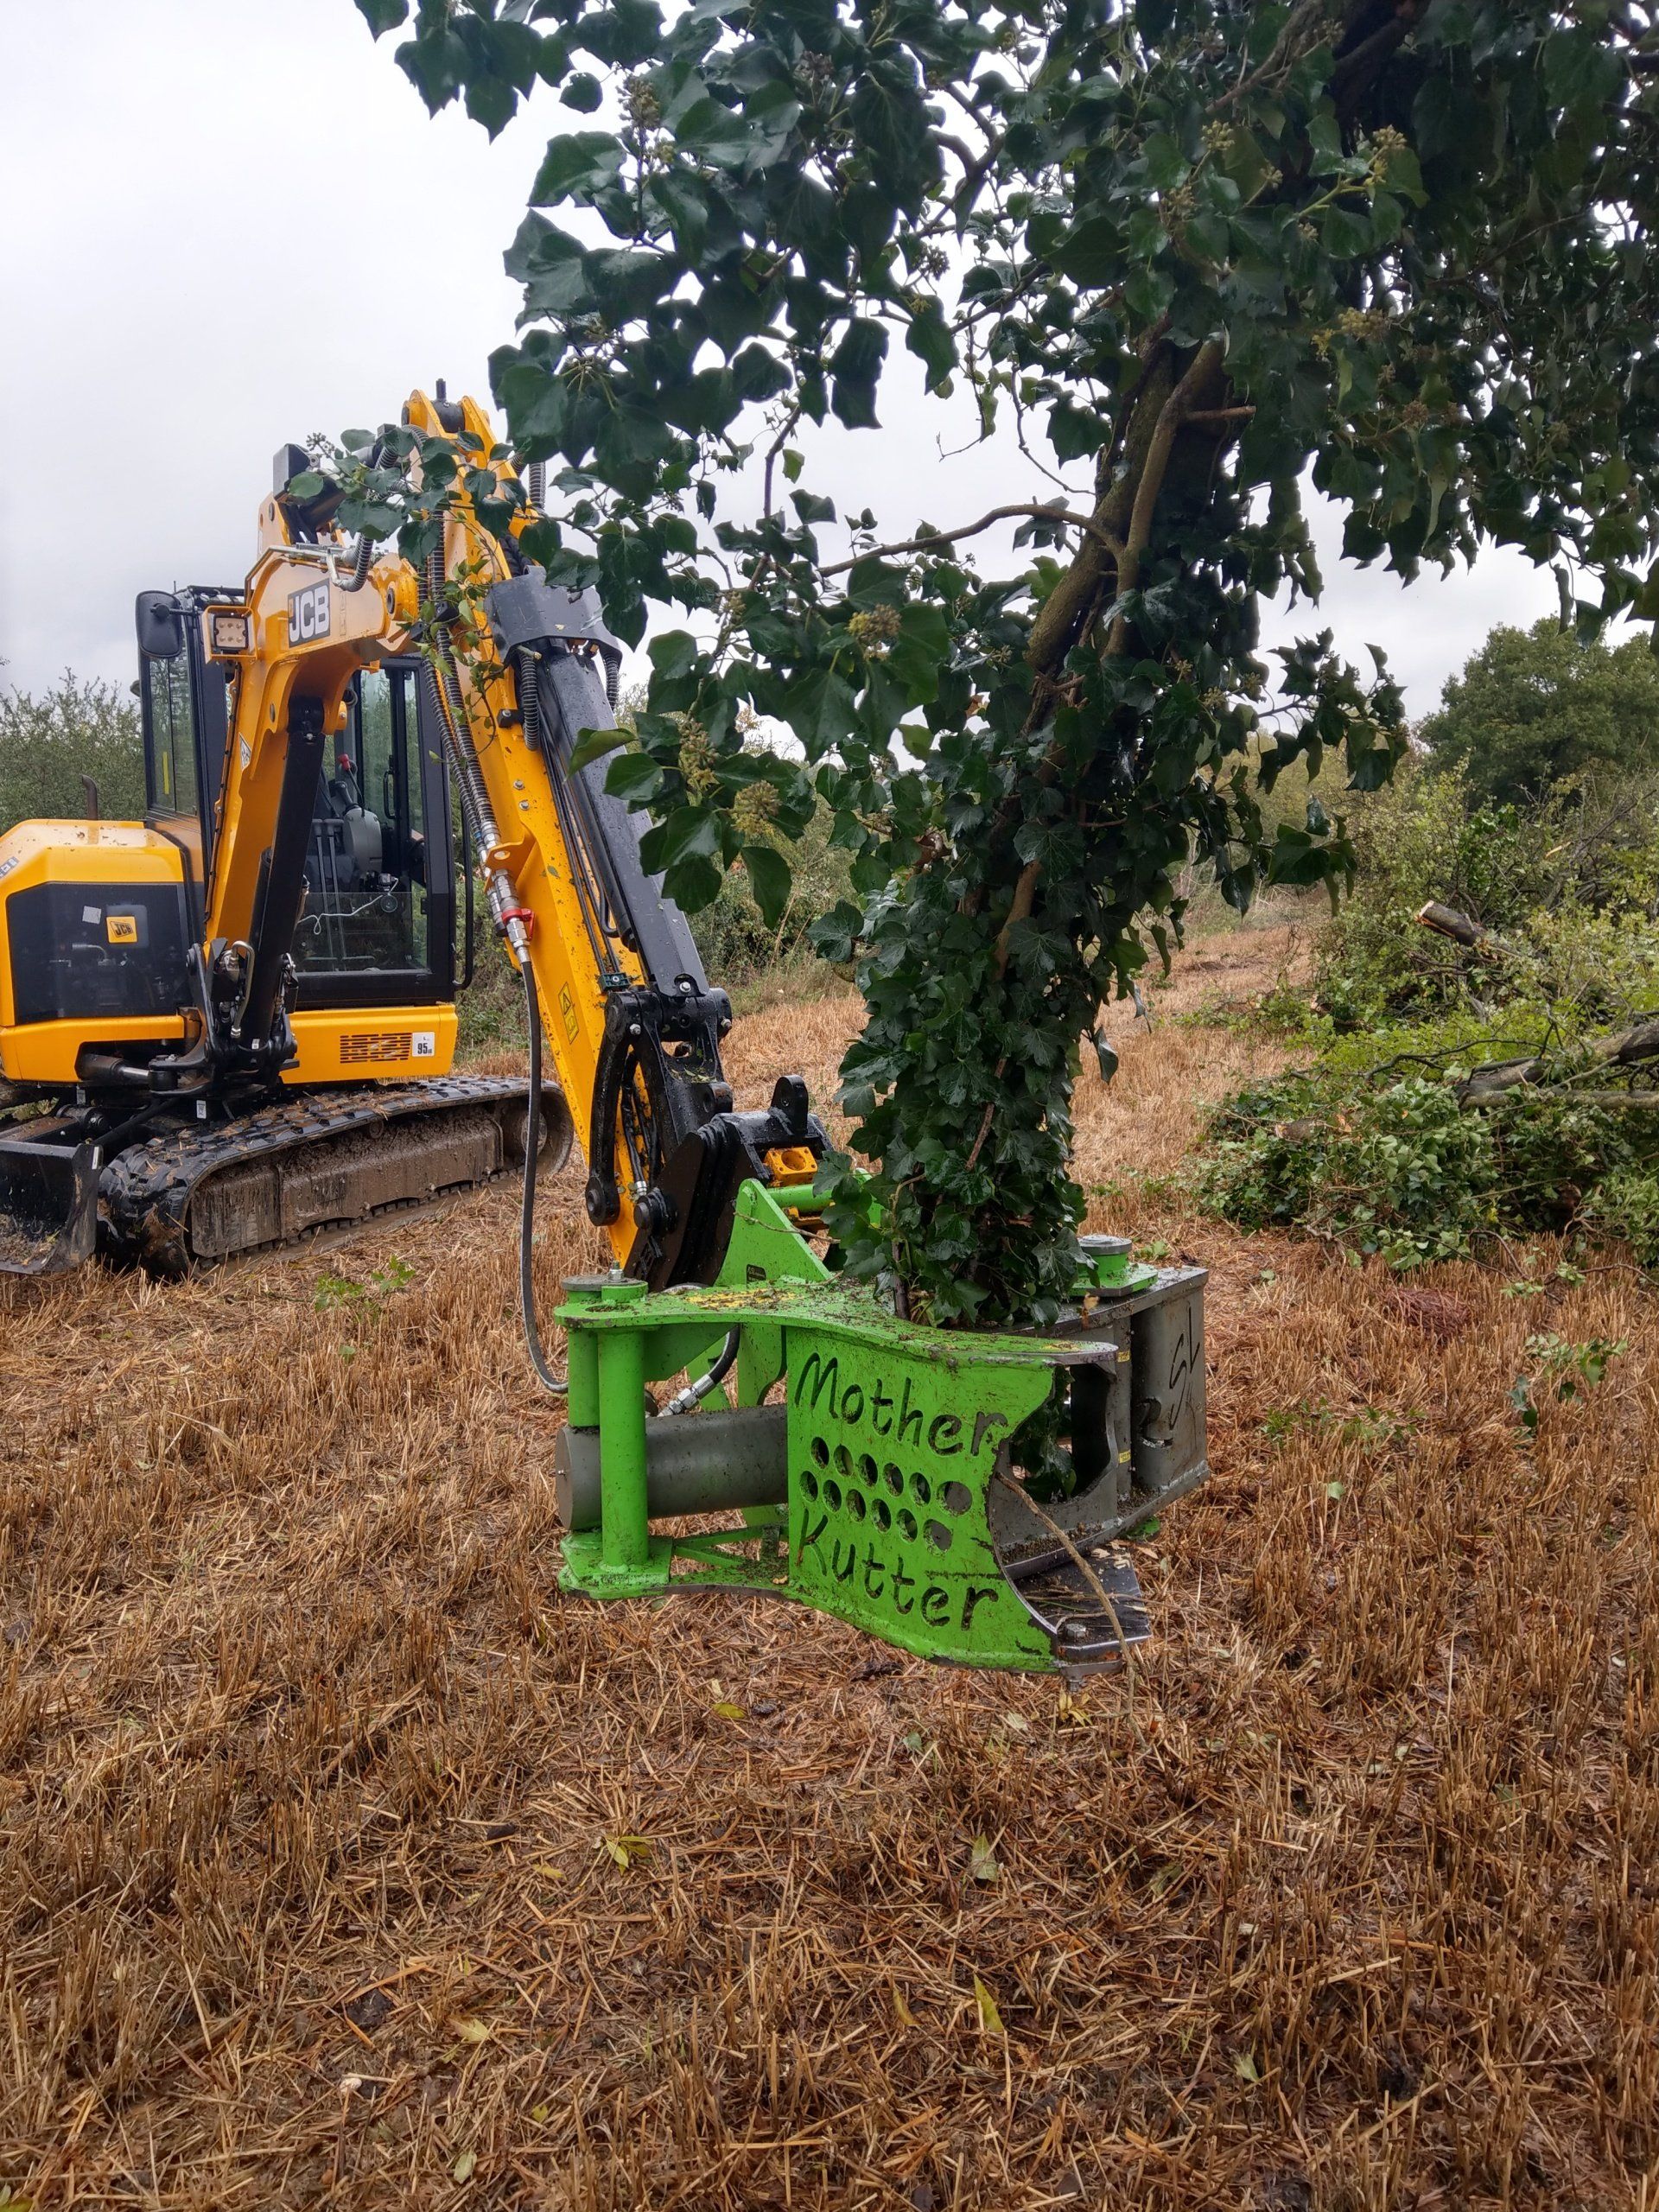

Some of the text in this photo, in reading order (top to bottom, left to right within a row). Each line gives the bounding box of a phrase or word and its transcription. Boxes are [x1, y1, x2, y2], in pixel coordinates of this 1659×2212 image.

[289, 585, 328, 642] JCB
[115, 923, 133, 935] JCB
[794, 1351, 1009, 1457] Mother
[796, 1508, 999, 1631] Kutter
